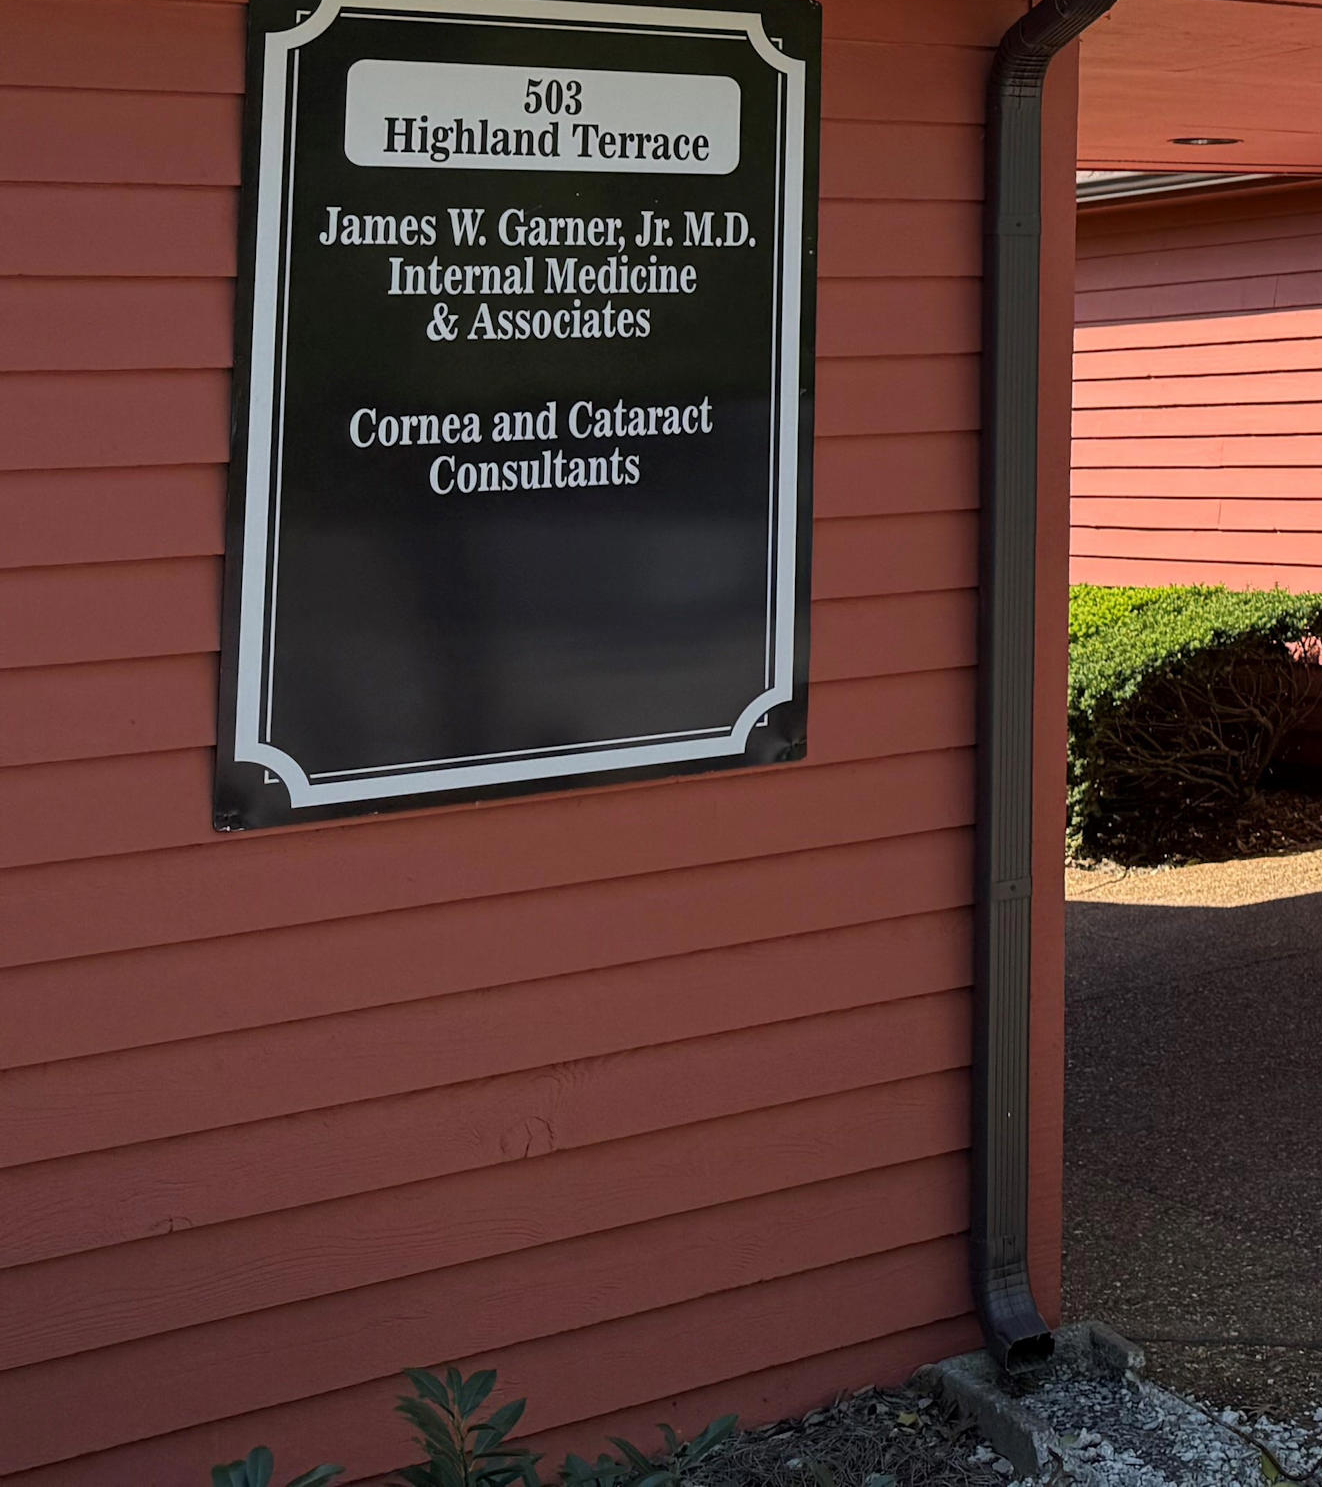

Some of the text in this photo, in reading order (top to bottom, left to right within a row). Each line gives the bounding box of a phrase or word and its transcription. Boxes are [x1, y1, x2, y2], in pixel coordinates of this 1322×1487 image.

[523, 78, 582, 116] 503
[383, 114, 710, 163] Highland Terrace
[319, 206, 756, 253] James W. Garner, Jr. M.D.
[387, 254, 697, 296] Internal Medicine
[426, 298, 651, 342] & Associates
[349, 395, 713, 448] Cornea and Cataract
[429, 446, 640, 495] Consultants
